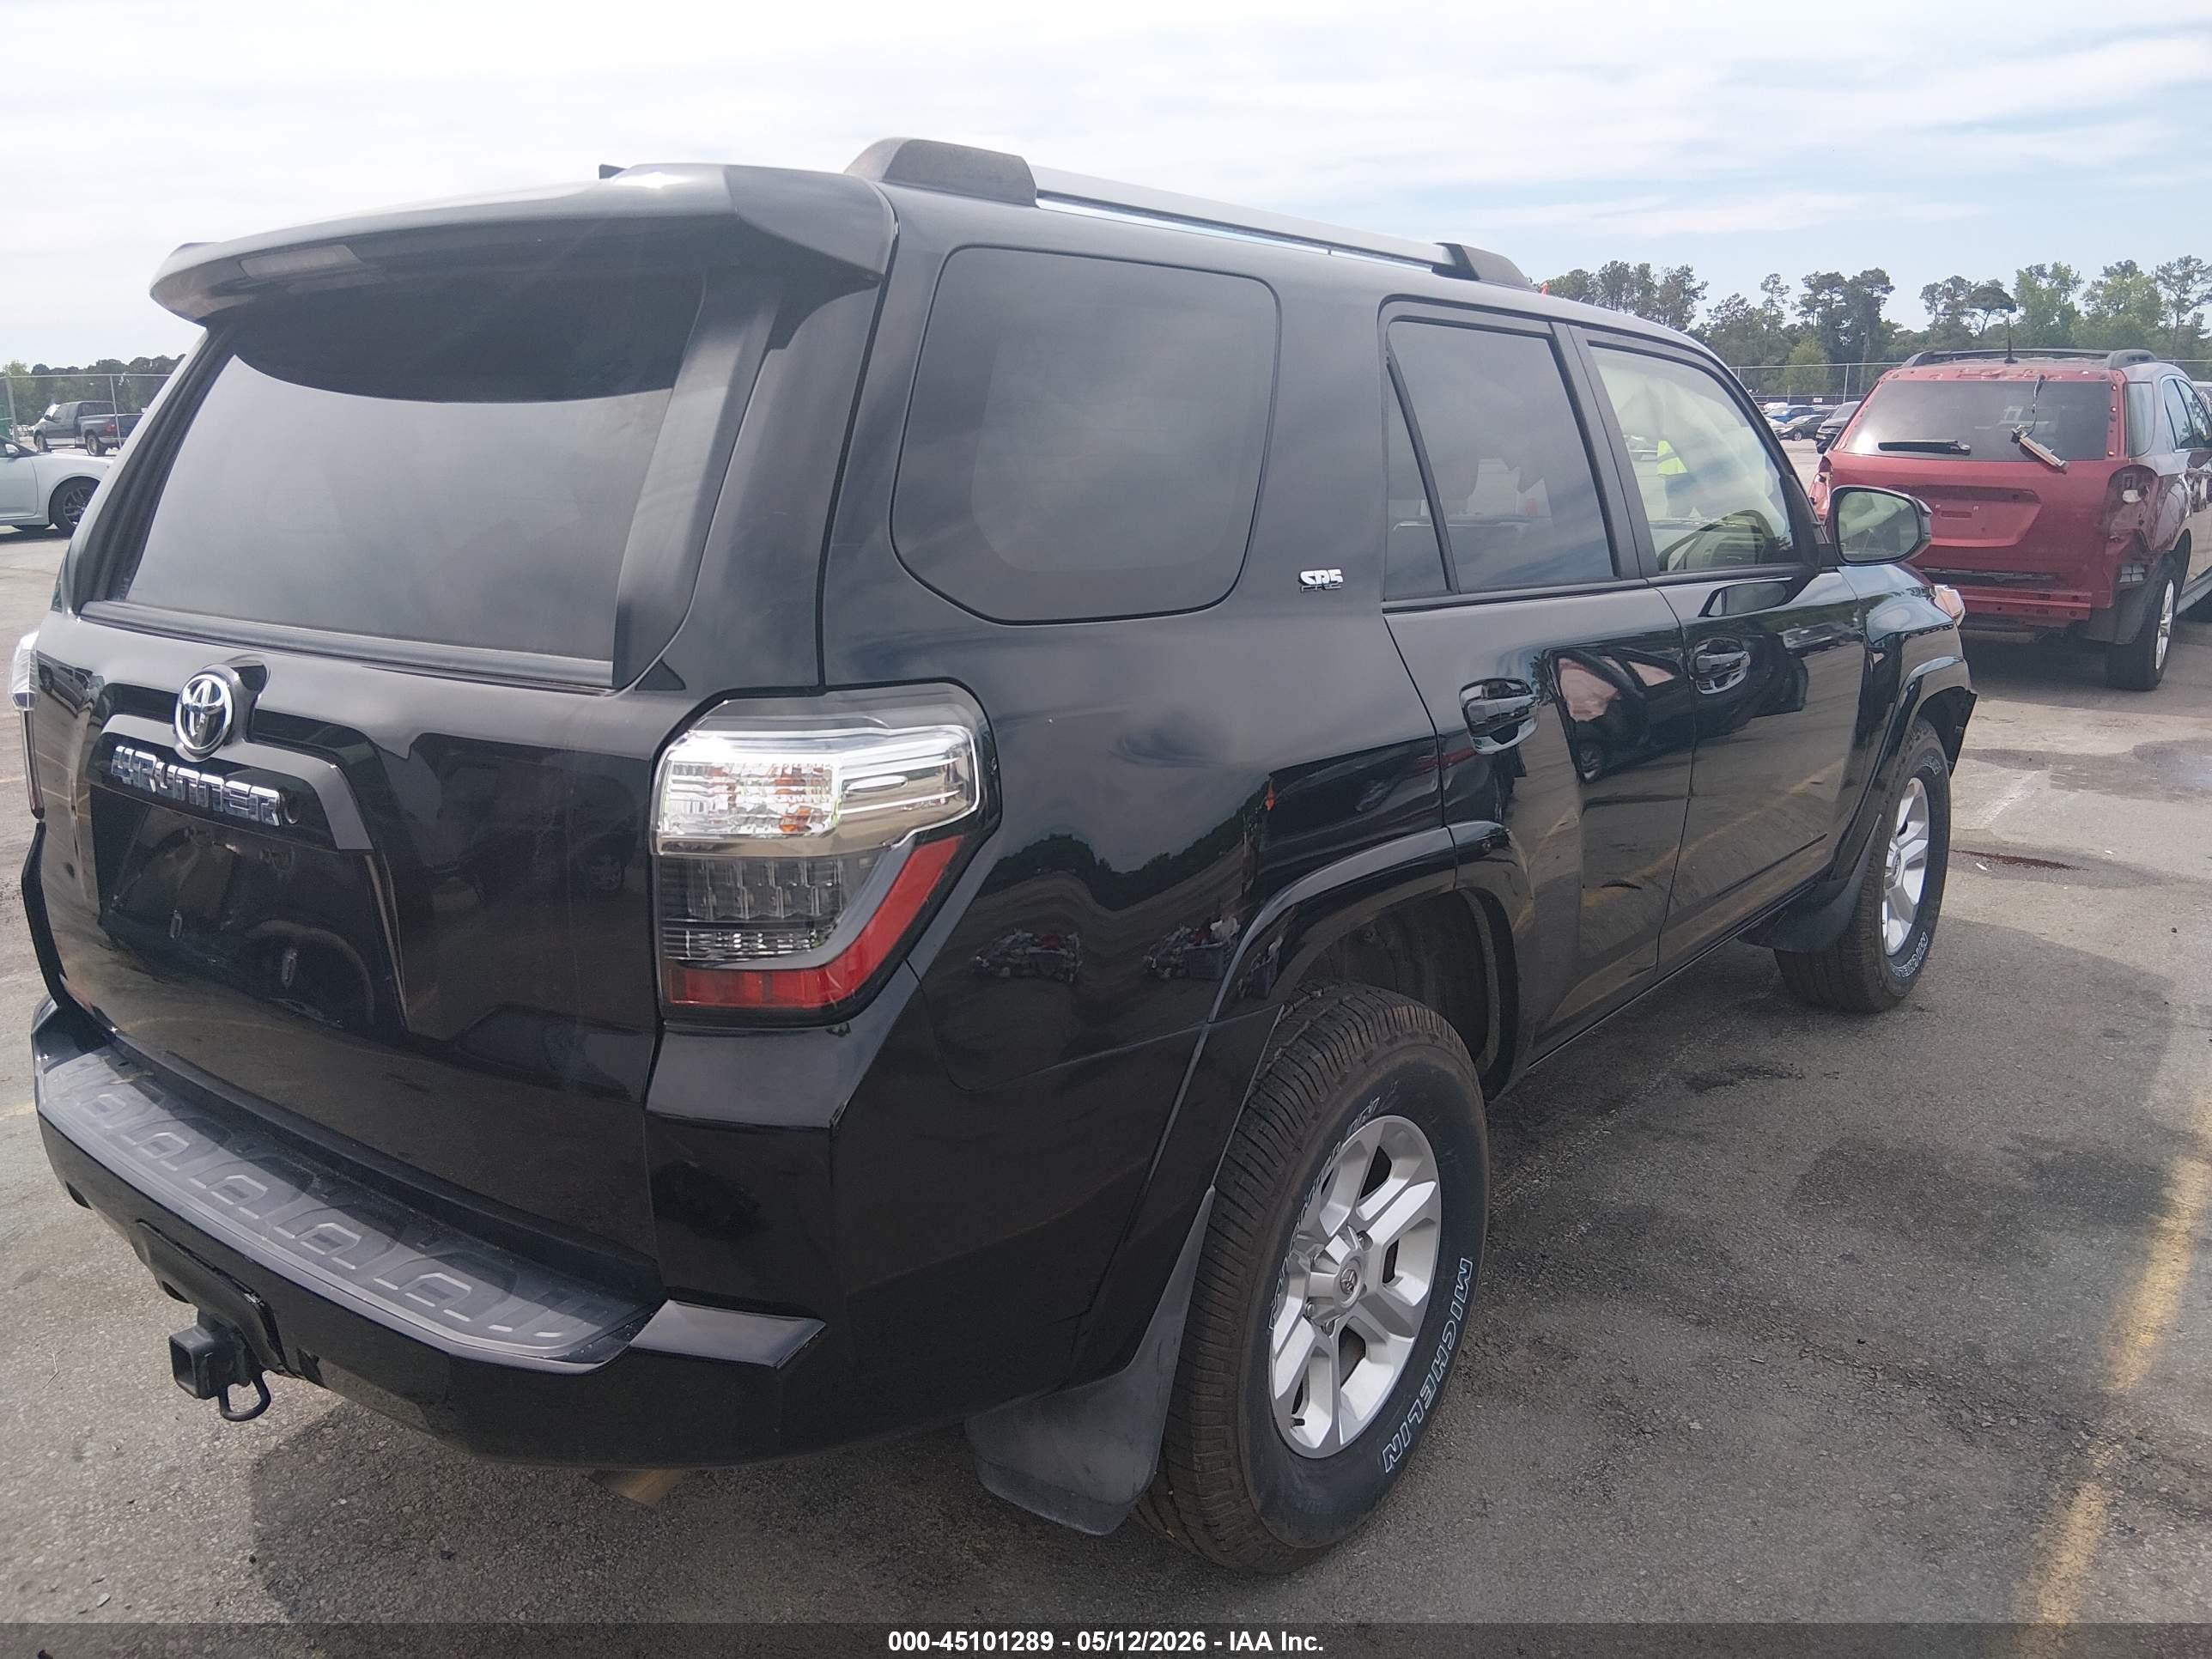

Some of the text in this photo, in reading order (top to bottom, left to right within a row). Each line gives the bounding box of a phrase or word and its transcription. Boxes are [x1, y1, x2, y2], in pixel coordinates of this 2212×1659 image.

[1298, 568, 1344, 593] SR5
[111, 745, 282, 827] 4RUNNER
[1381, 1257, 1474, 1474] MICHELIN
